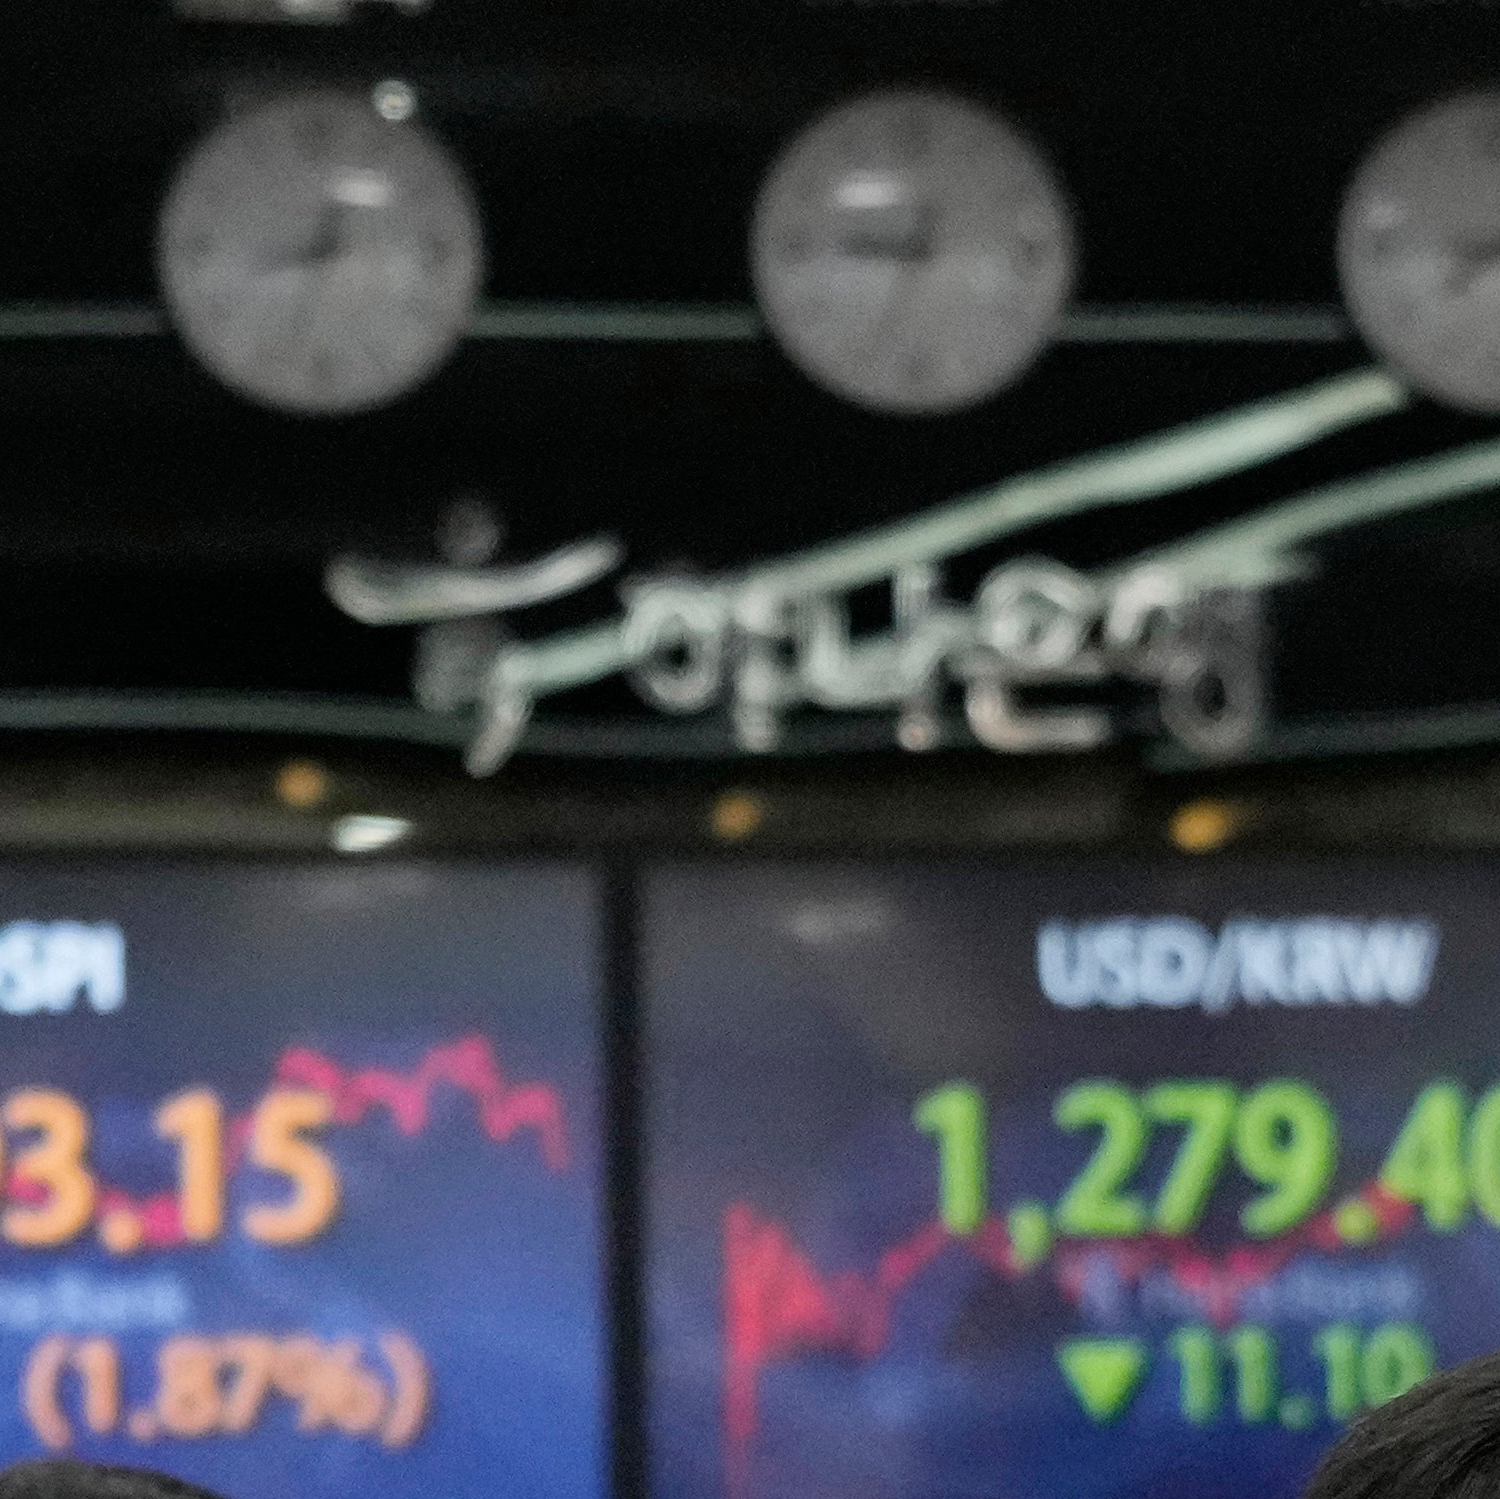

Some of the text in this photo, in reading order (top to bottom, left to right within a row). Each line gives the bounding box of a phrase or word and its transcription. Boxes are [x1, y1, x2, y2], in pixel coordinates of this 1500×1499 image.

[1038, 916, 1439, 1010] USD/KRW
[23, 1330, 431, 1450] (1.87%)
[1168, 1322, 1436, 1431] 11.10
